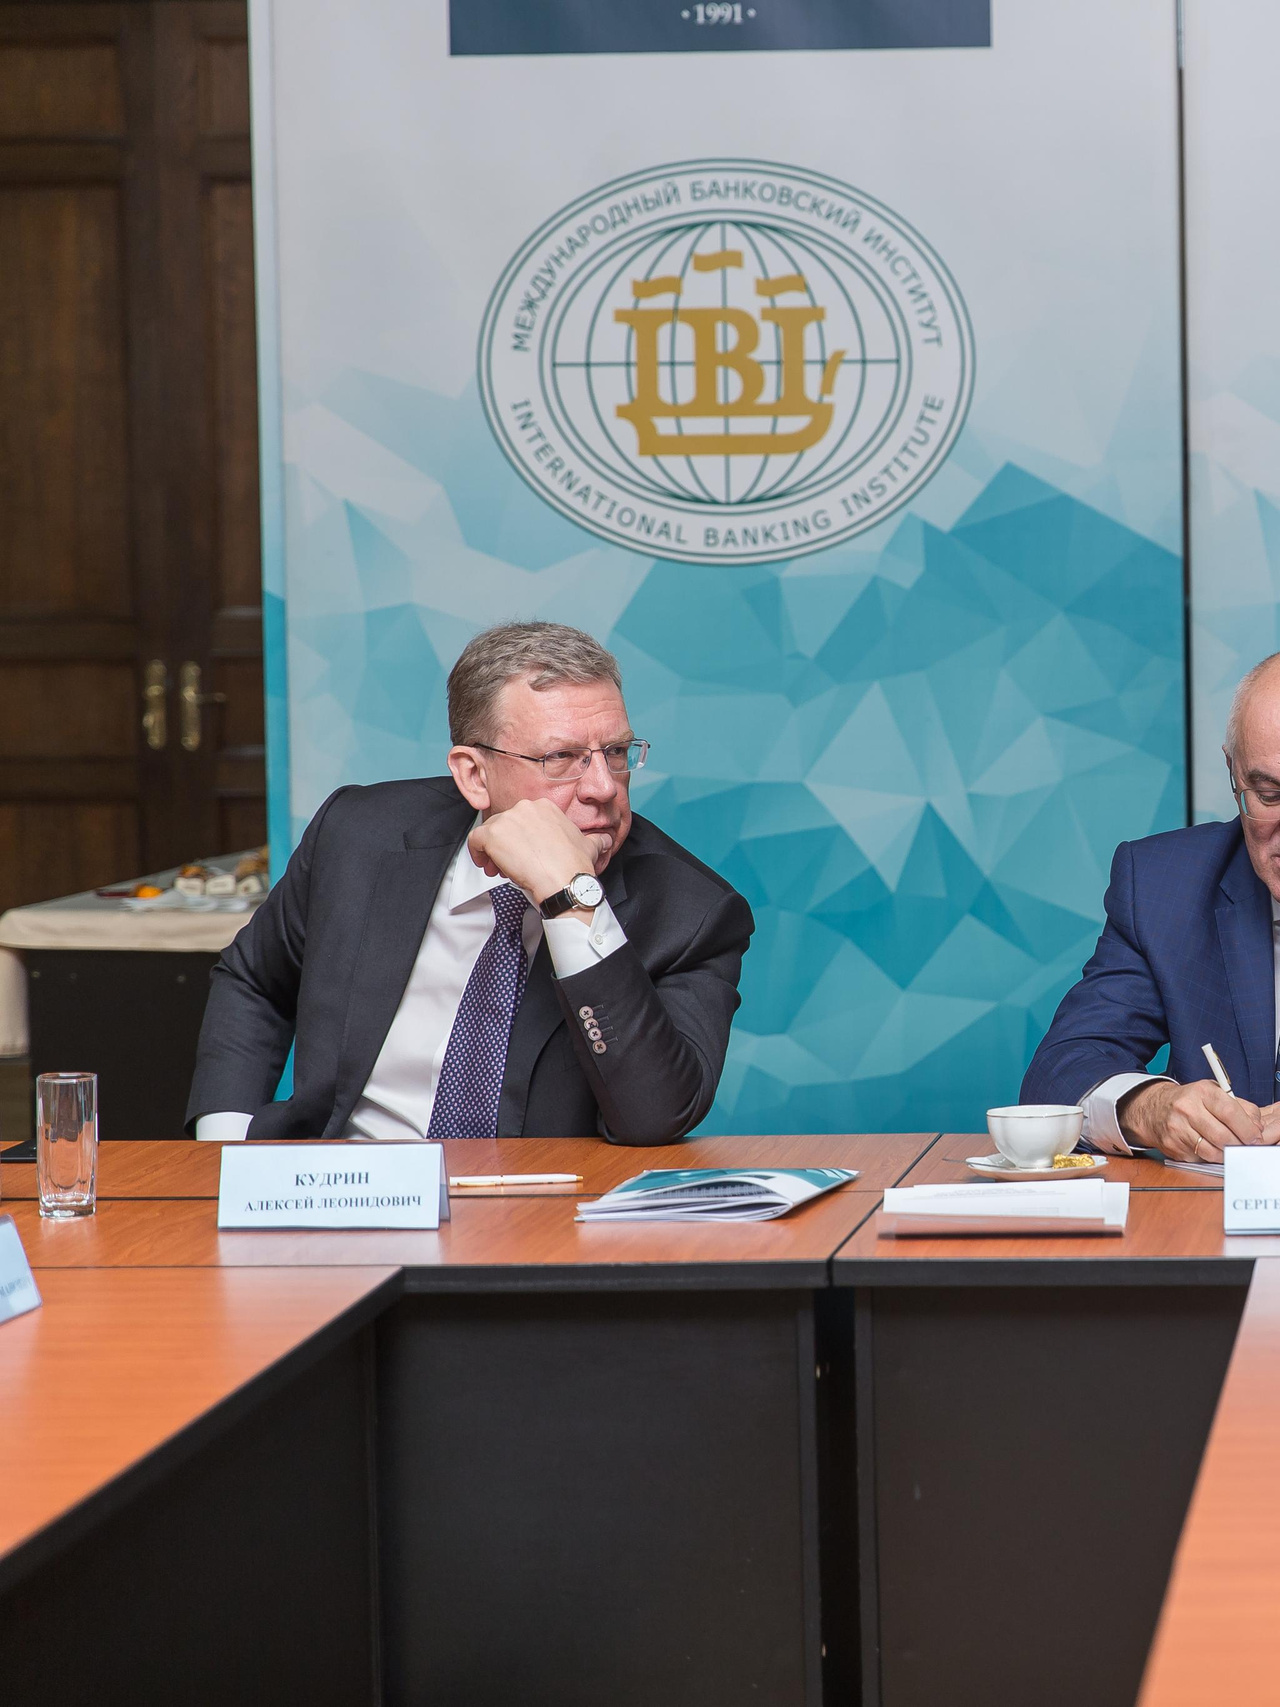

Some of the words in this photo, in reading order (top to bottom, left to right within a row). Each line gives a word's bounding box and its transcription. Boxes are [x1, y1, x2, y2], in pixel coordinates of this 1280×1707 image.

[693, 2, 744, 25] 1991
[510, 180, 682, 353] МЕЖДУНАРОДНЫЙ
[689, 179, 864, 236] БАНКОВСКИЙ
[861, 225, 944, 349] ИНСТИТУТ
[510, 397, 689, 545] INTERNATIONAL
[704, 508, 833, 548] BANKING
[838, 393, 945, 518] INSTITUTE
[295, 1171, 370, 1188] КУДРИН
[244, 1196, 314, 1212] АЛЕКСЕЙ
[317, 1195, 422, 1210] ЛЕОНИДОВИЧ
